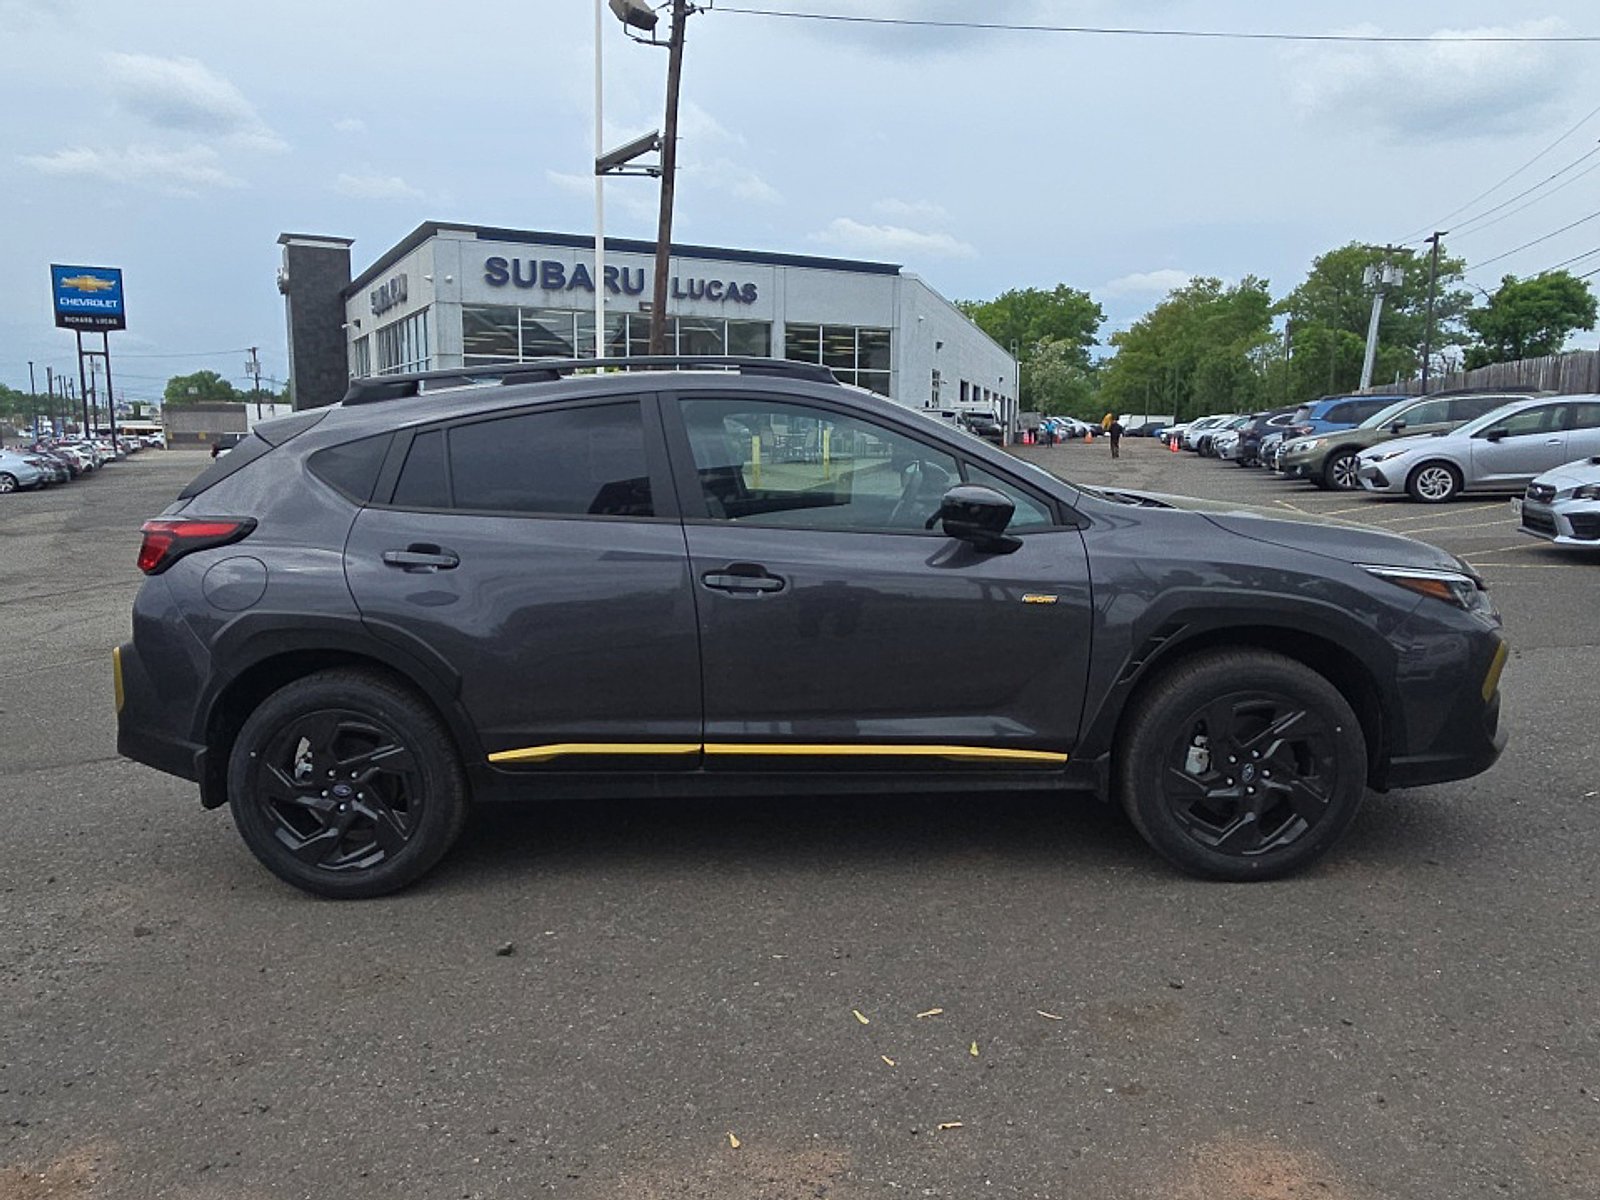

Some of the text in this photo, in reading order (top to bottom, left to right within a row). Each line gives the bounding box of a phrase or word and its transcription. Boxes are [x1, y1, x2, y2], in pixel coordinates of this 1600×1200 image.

[485, 256, 758, 305] SUBARU LUCAS
[60, 297, 118, 308] CHEVROLET
